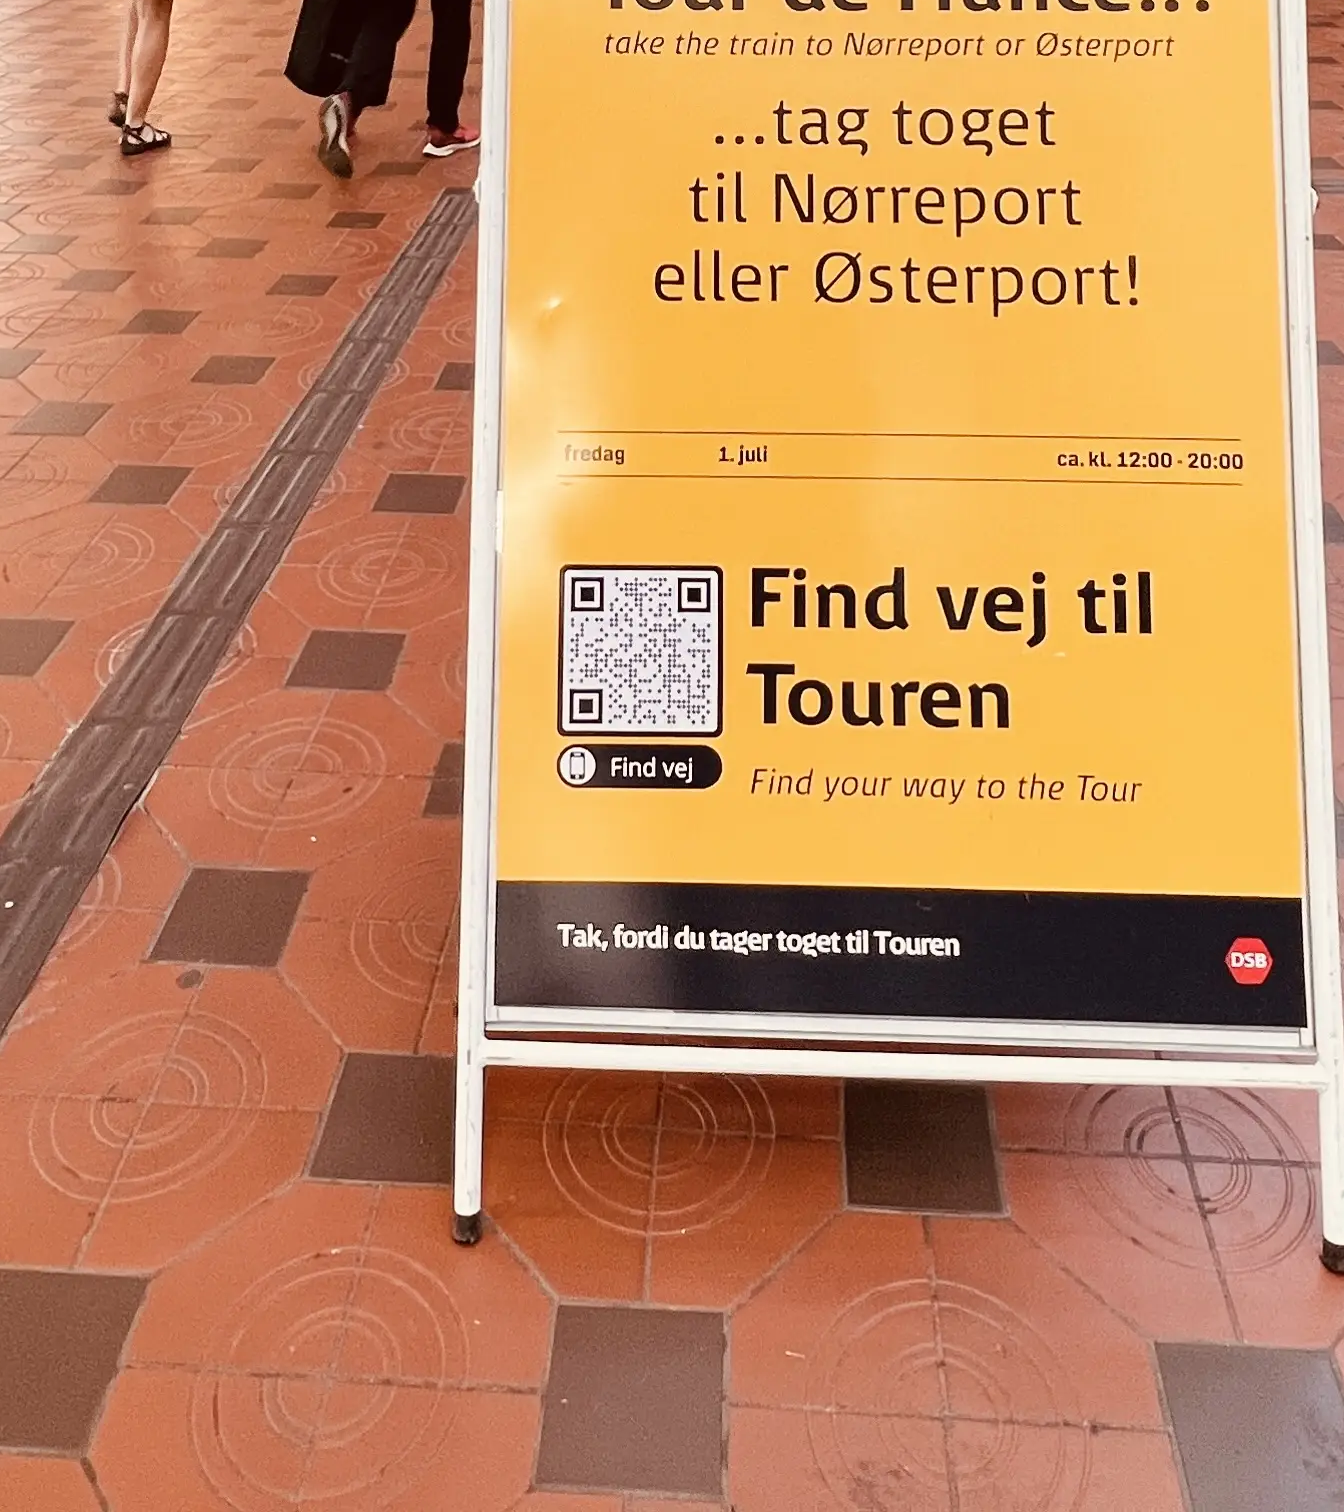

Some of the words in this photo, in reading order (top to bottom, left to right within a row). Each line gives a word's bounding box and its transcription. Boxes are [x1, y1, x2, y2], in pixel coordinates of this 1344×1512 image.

[605, 30, 665, 55] take
[675, 30, 719, 56] the
[730, 31, 794, 56] train
[806, 35, 833, 56] to
[843, 32, 985, 62] Nørreport
[995, 38, 1026, 57] or
[1036, 32, 1175, 63] Østerport
[714, 100, 870, 157] ...tag
[891, 100, 1056, 157] toget
[688, 170, 747, 223] til
[774, 173, 1082, 238] Nørreport
[654, 249, 789, 303] eller
[814, 251, 1138, 318] Østerport!
[563, 443, 626, 467] fredag
[718, 446, 735, 463] 1.
[737, 444, 768, 466] juli
[1057, 453, 1085, 467] ca.
[1088, 451, 1112, 468] kl.
[1116, 451, 1173, 469] 12:00
[1187, 452, 1244, 470] 20:00
[751, 566, 909, 631] Find
[936, 571, 1047, 649] vej
[1076, 571, 1153, 635] til
[745, 663, 1010, 729] Touren
[610, 756, 657, 778] Find
[661, 756, 693, 784] vej
[750, 768, 814, 796] Find
[823, 776, 893, 802] your
[903, 777, 966, 805] way
[977, 776, 1005, 799] to
[1018, 772, 1065, 801] the
[1077, 774, 1143, 802] Tour
[556, 922, 609, 952] Tak,
[612, 923, 669, 950] fordi
[673, 924, 706, 950] du
[708, 928, 773, 956] tager
[775, 930, 842, 958] toget
[844, 929, 870, 955] til
[872, 930, 961, 957] Touren
[1230, 952, 1268, 969] DSB
